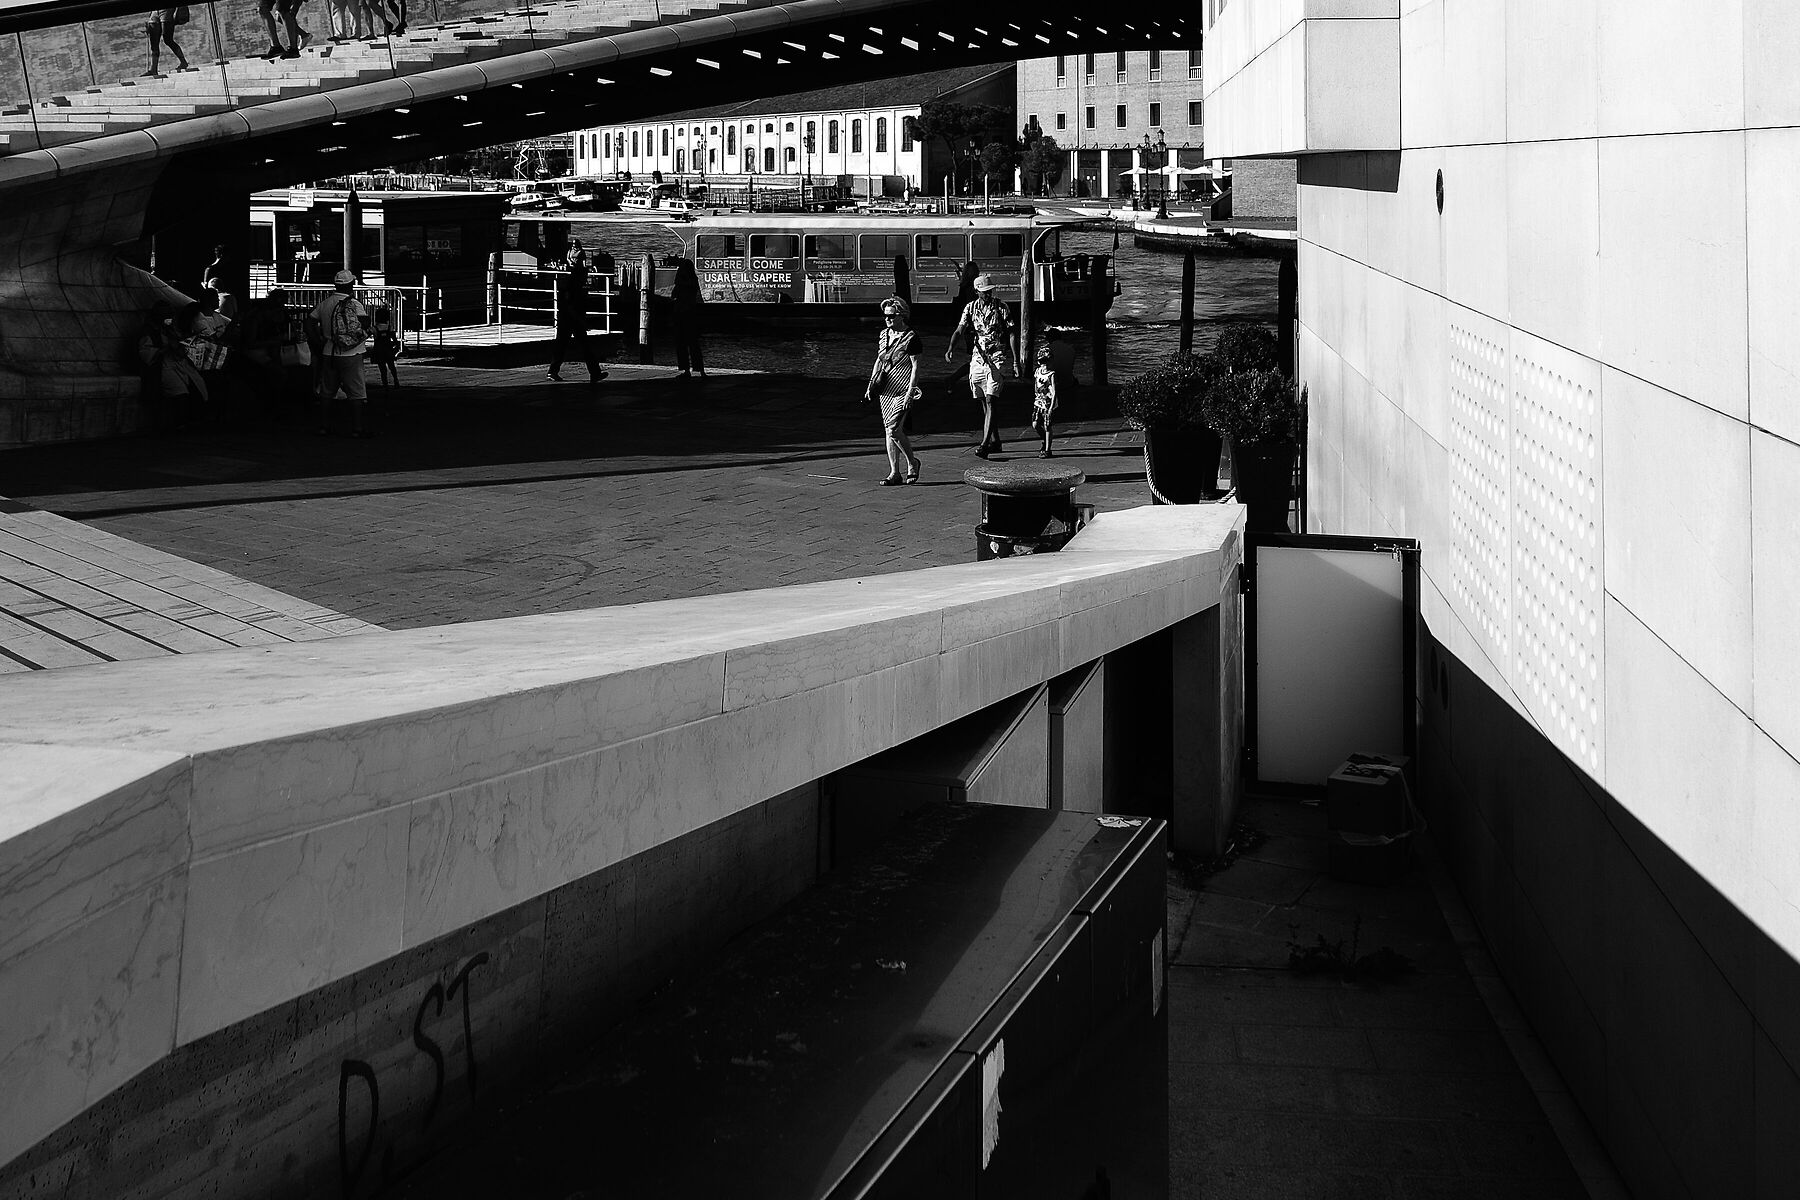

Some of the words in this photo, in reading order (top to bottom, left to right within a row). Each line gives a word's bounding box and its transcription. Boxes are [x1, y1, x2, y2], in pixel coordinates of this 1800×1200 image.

[704, 260, 742, 269] SAPERE
[753, 260, 784, 269] COME
[704, 273, 737, 282] USARE
[741, 273, 750, 282] IL
[753, 273, 792, 282] SAPERE
